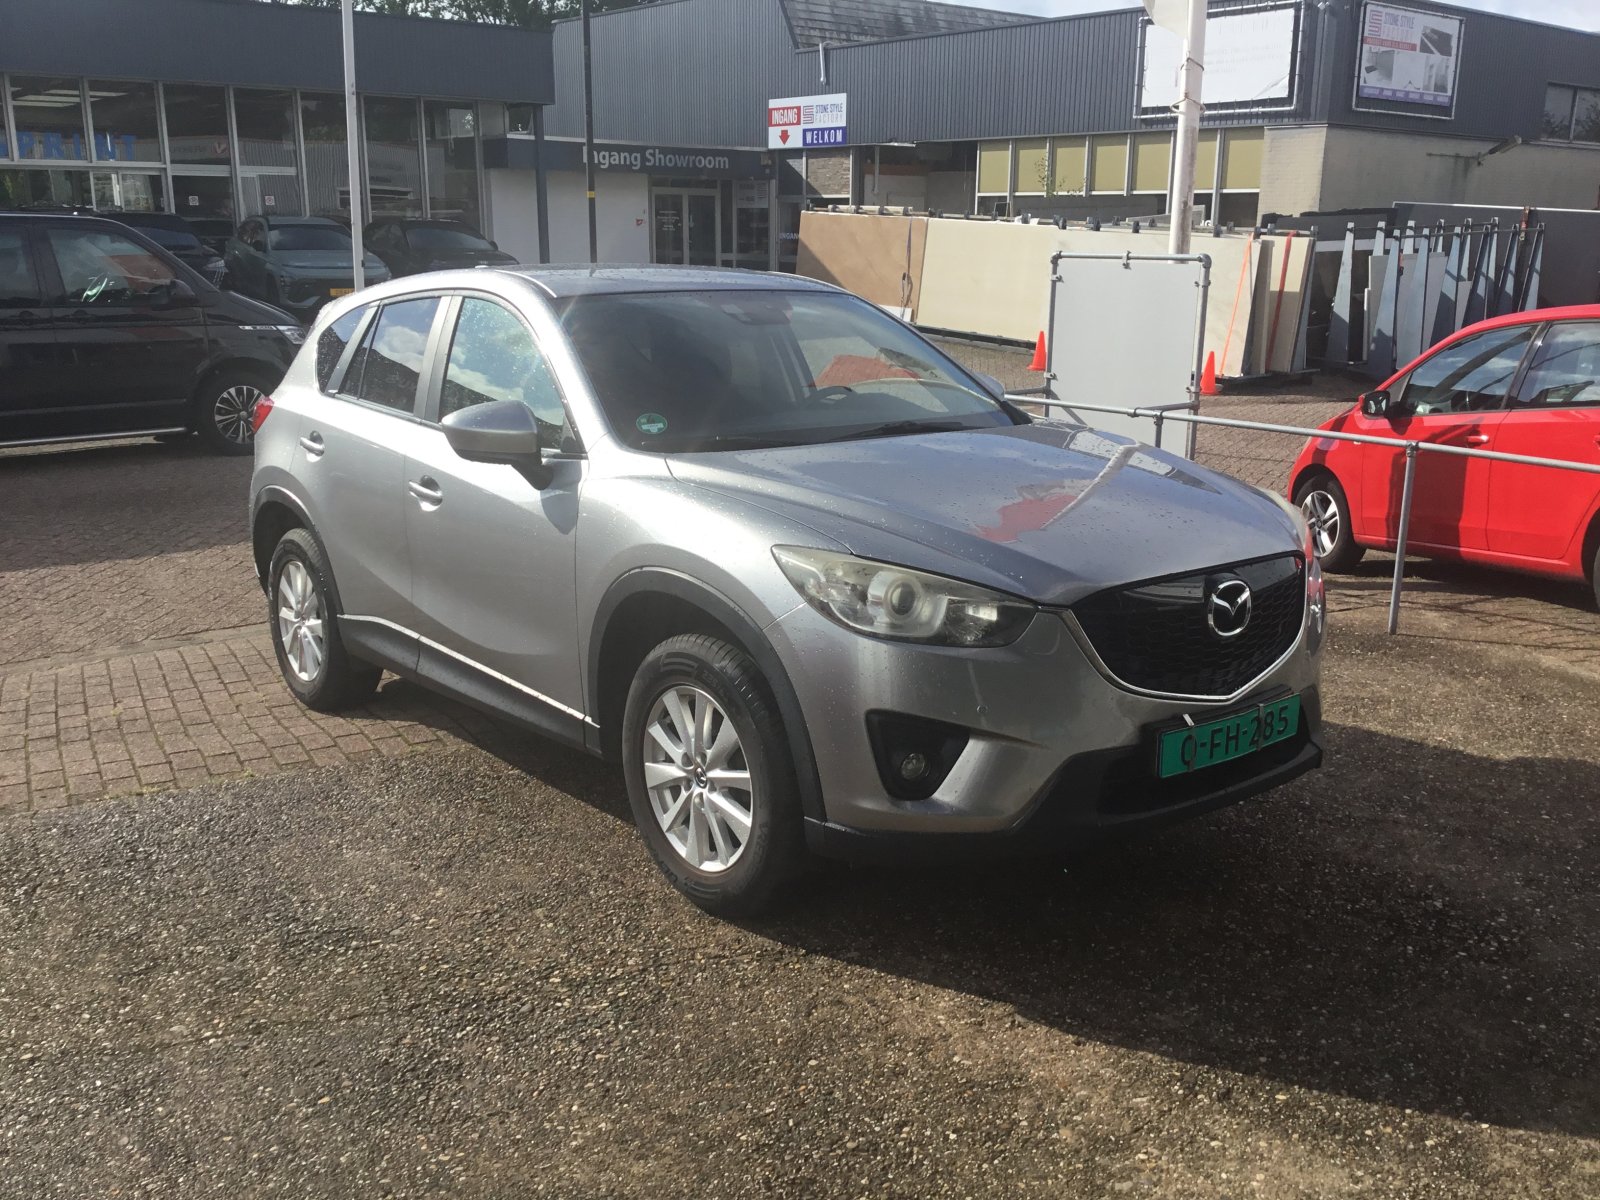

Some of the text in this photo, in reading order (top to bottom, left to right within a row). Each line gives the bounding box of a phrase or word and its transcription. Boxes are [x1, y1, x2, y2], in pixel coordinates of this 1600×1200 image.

[1400, 15, 1415, 29] STYLE
[815, 103, 843, 114] STONE STYLE
[772, 108, 798, 125] INGANG
[805, 129, 843, 144] WELKOM
[645, 148, 729, 169] Showroom
